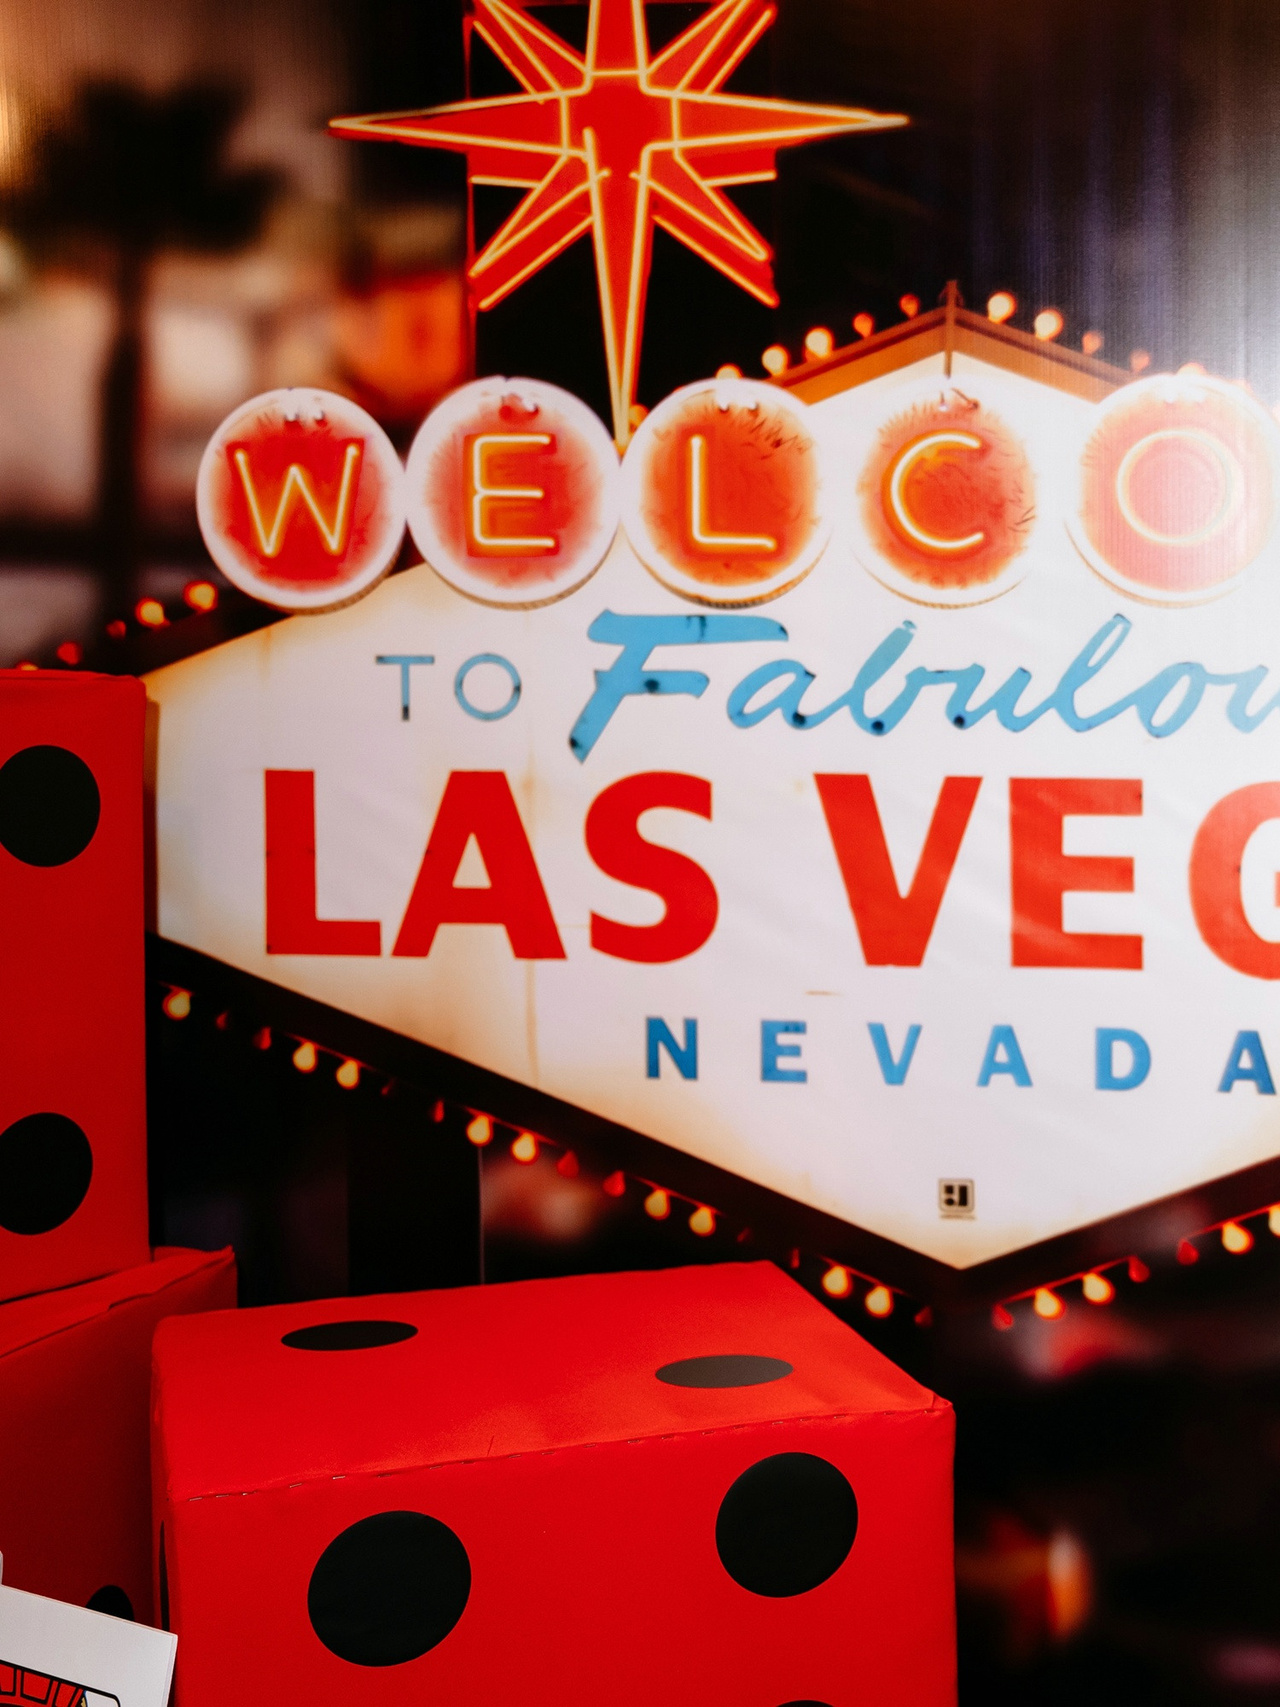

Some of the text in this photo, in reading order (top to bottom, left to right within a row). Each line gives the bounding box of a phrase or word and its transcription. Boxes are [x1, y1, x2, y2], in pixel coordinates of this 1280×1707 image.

[375, 652, 523, 722] TO
[263, 768, 720, 964] LAS
[645, 1016, 1277, 1095] NEVADA
